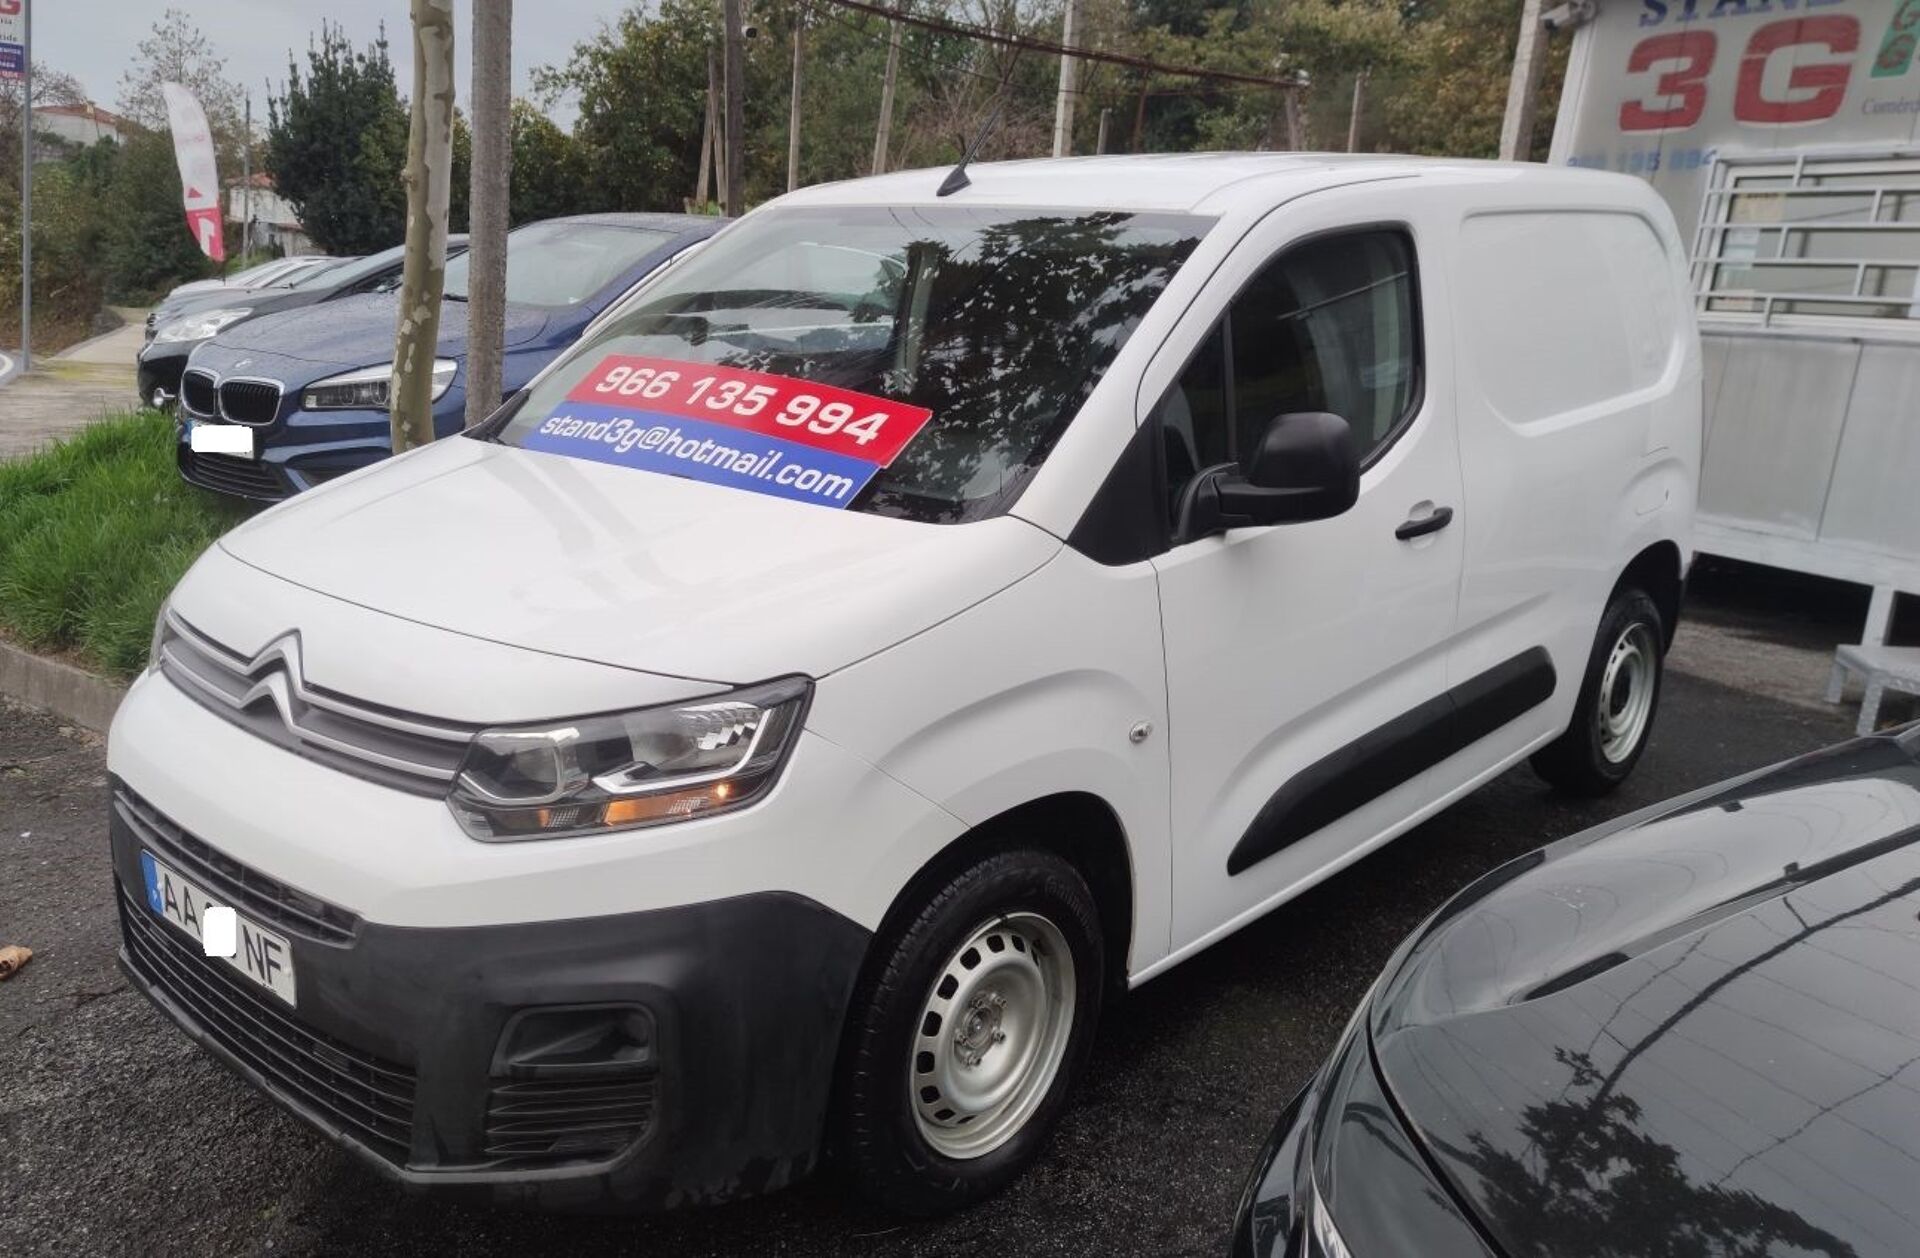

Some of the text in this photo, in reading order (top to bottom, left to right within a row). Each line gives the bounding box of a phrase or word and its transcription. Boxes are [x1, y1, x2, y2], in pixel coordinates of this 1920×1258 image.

[1619, 14, 1861, 132] 3G
[595, 366, 890, 446] 966 135 994
[540, 415, 854, 500] stand3g@hotmail.com
[164, 872, 282, 985] AA NF
